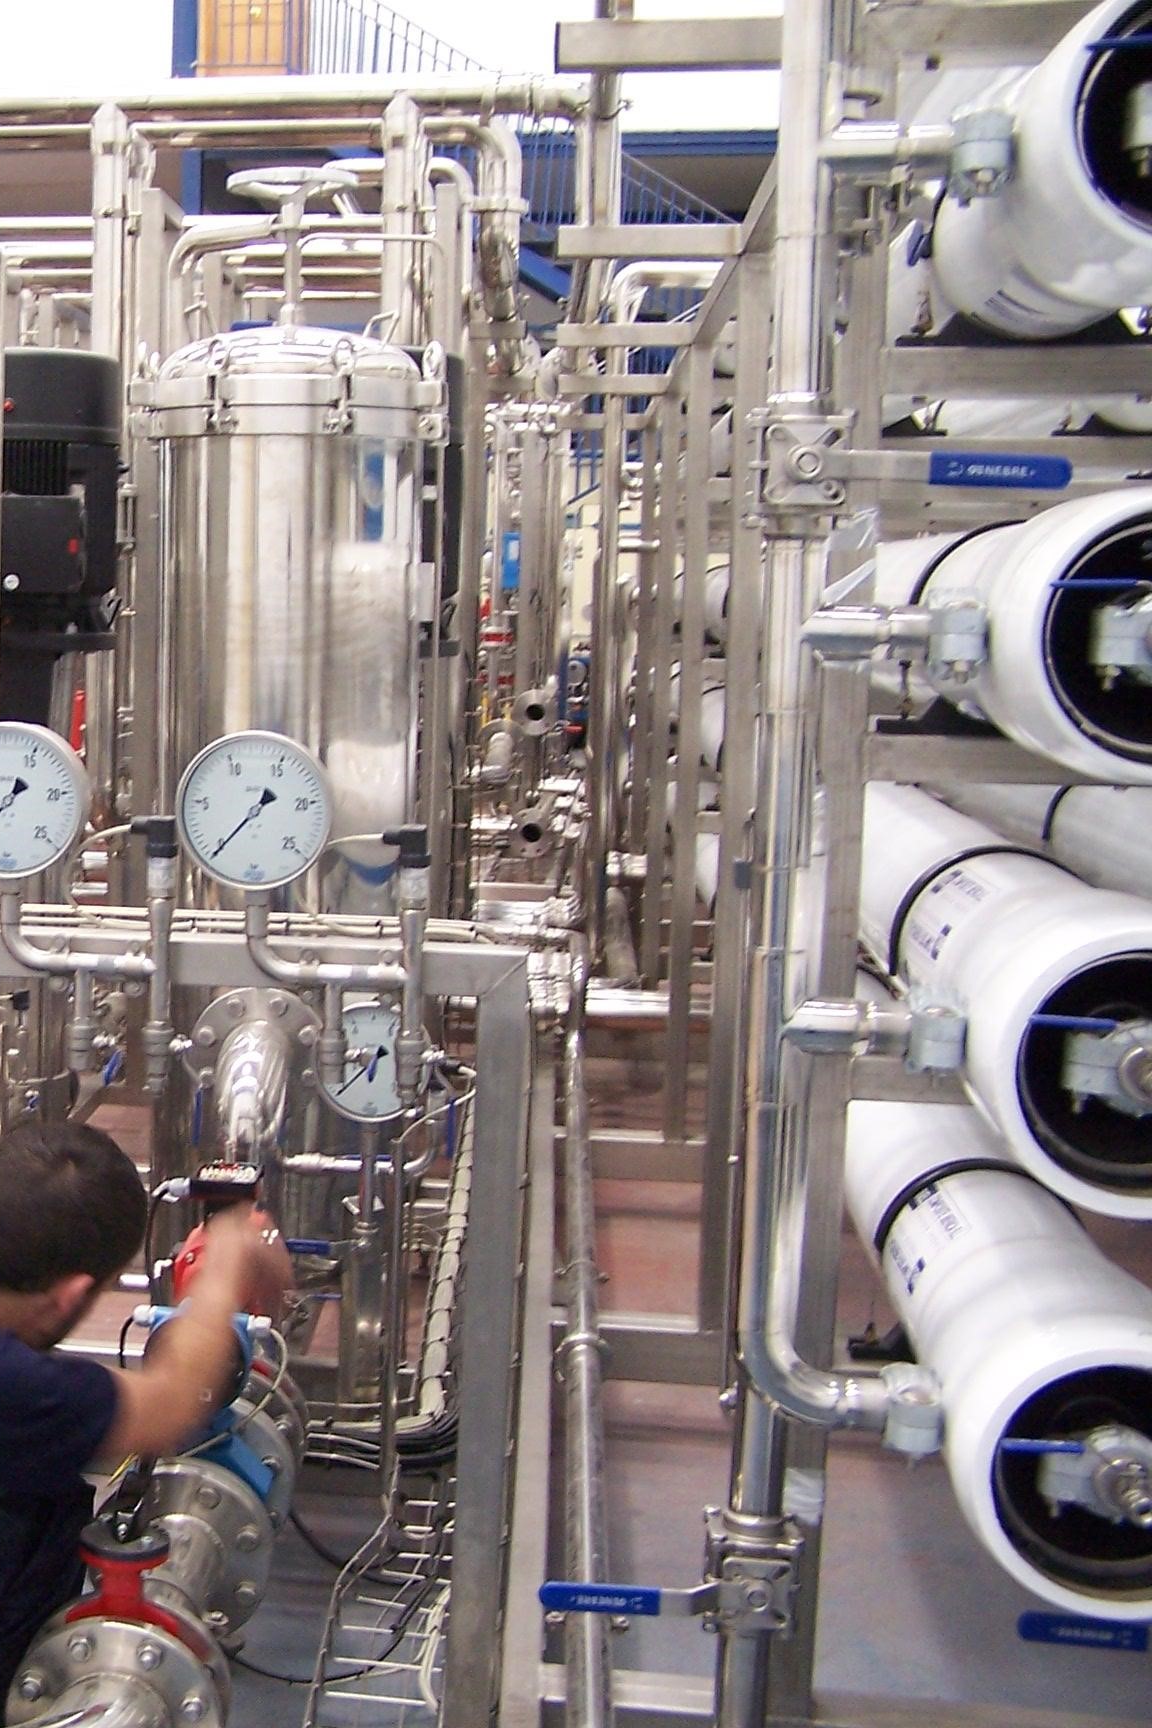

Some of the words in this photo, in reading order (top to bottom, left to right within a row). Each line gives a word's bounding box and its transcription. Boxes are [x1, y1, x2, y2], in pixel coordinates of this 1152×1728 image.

[24, 755, 36, 768] 15
[229, 762, 242, 776] 10
[271, 764, 284, 777] 15
[47, 788, 61, 801] 20
[202, 797, 209, 810] 5
[295, 797, 309, 811] 20
[34, 826, 47, 839] 25
[282, 837, 295, 850] 25
